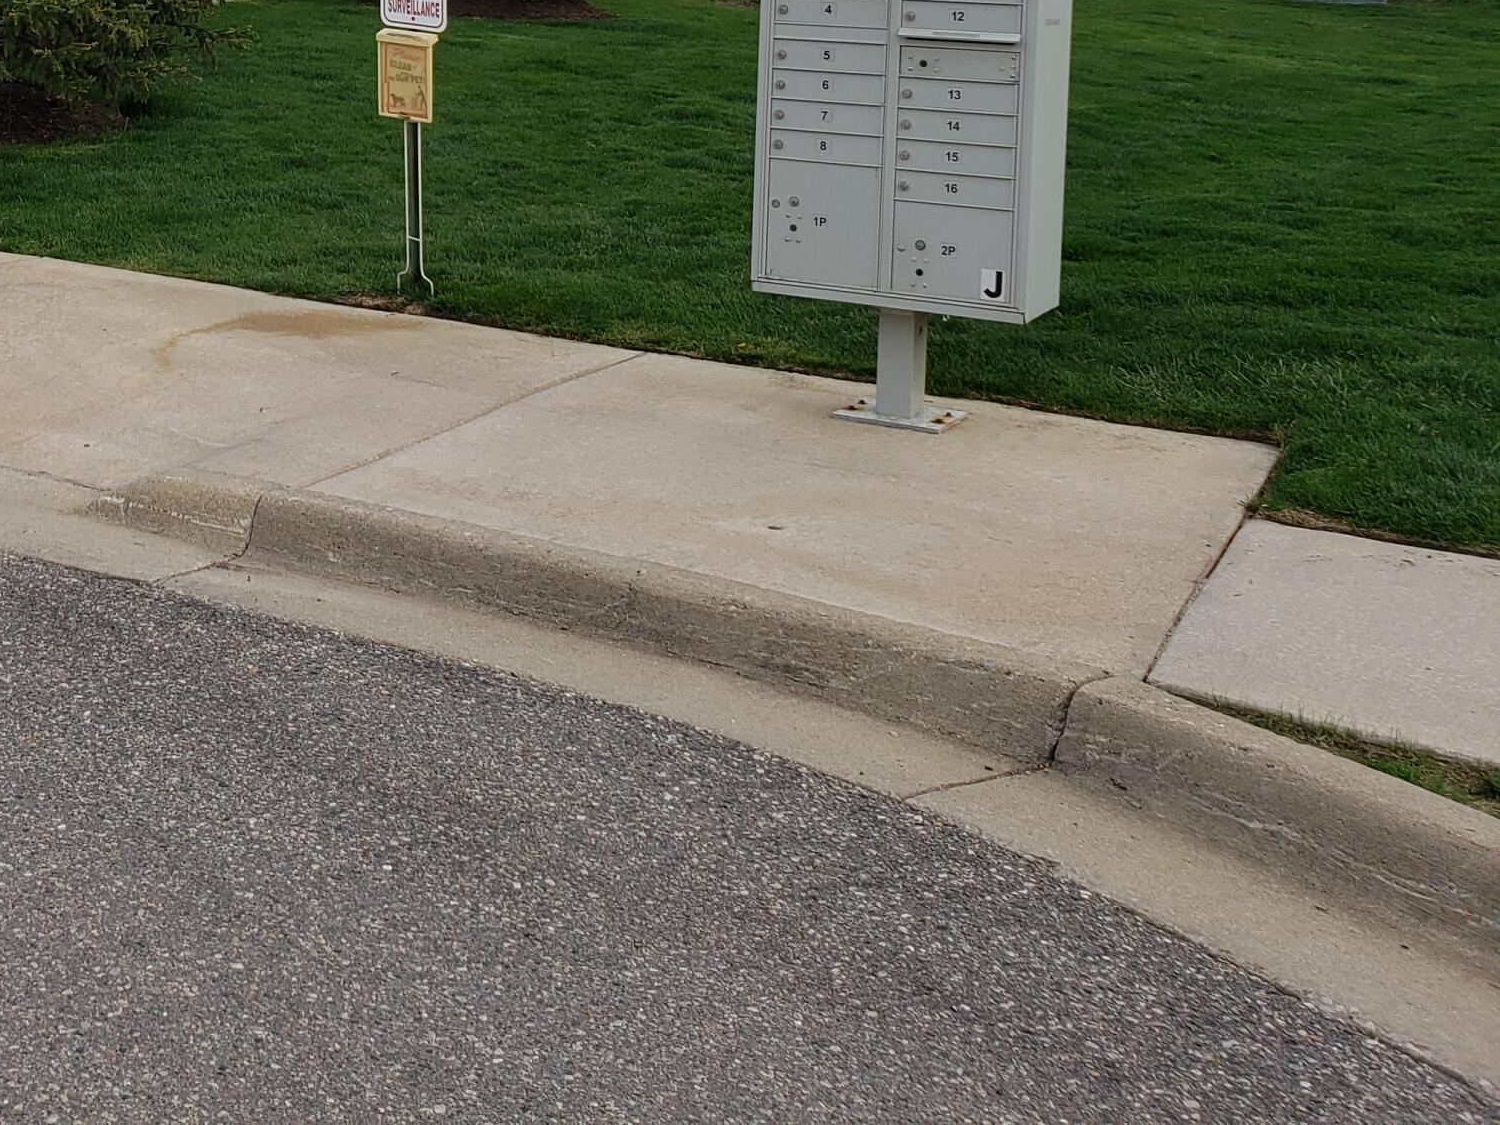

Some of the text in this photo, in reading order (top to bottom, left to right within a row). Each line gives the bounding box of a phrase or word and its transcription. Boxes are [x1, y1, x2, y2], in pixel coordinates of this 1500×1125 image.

[824, 4, 832, 15] 4
[951, 11, 965, 22] 12
[823, 50, 831, 61] 5
[822, 79, 829, 90] 6
[947, 89, 961, 100] 13
[821, 110, 828, 121] 7
[946, 121, 960, 132] 14
[819, 140, 827, 151] 8
[945, 151, 959, 163] 15
[944, 183, 958, 194] 16
[813, 216, 827, 227] 1P
[941, 245, 956, 256] 2P
[983, 270, 1003, 299] J
